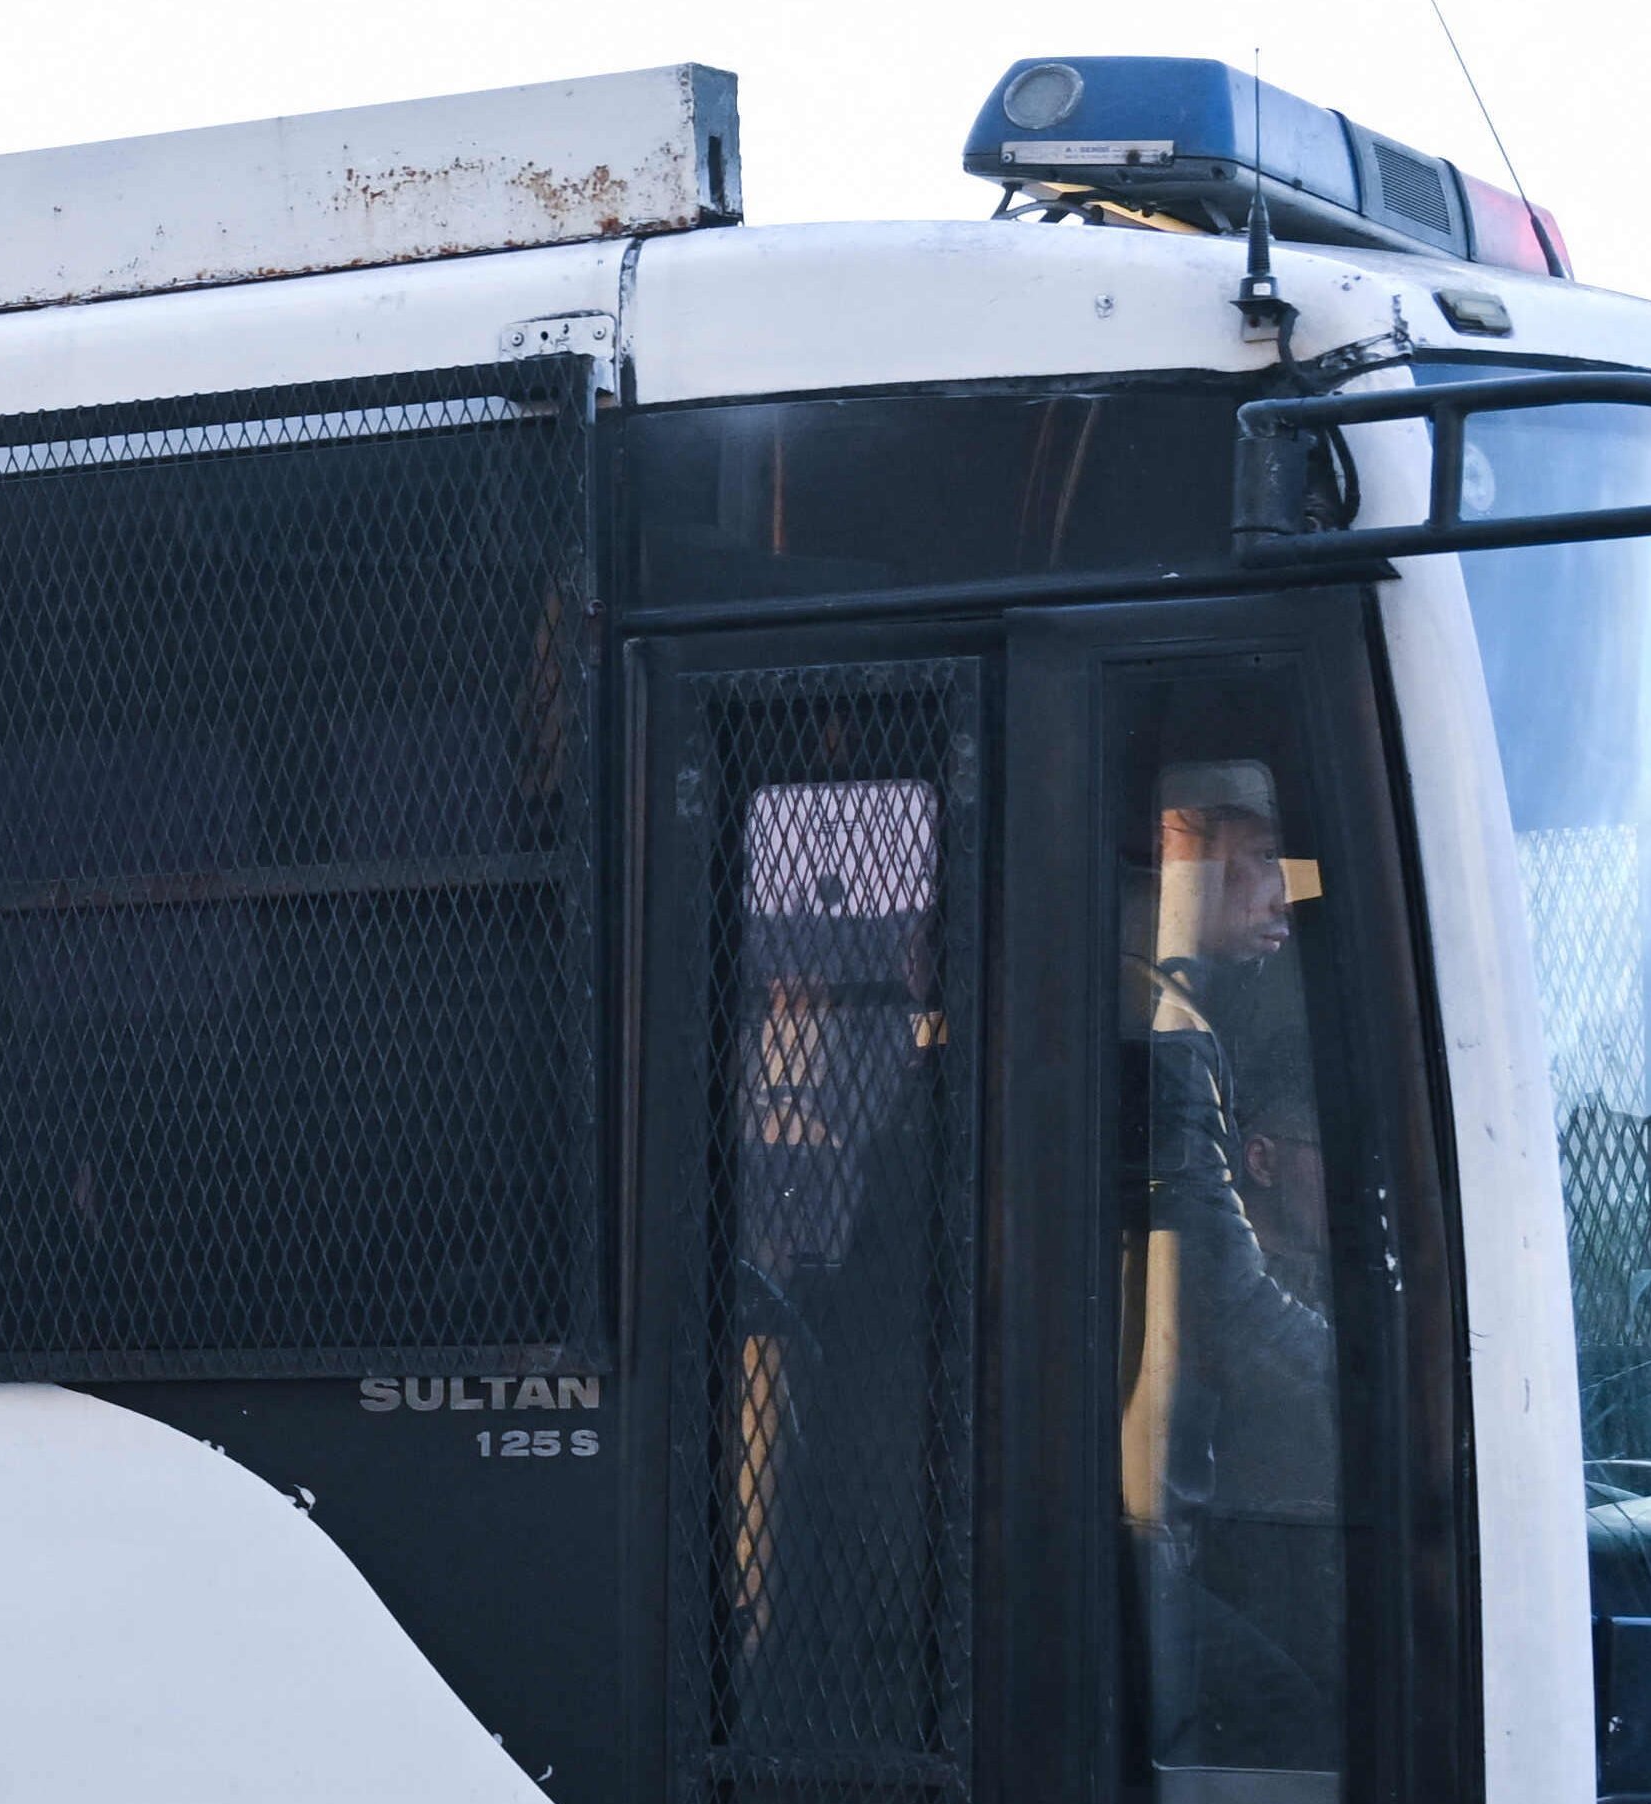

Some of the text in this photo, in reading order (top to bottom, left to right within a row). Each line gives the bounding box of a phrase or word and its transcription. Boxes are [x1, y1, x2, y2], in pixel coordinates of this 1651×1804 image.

[359, 1375, 601, 1412] SULTAN
[475, 1428, 601, 1458] 125 S
